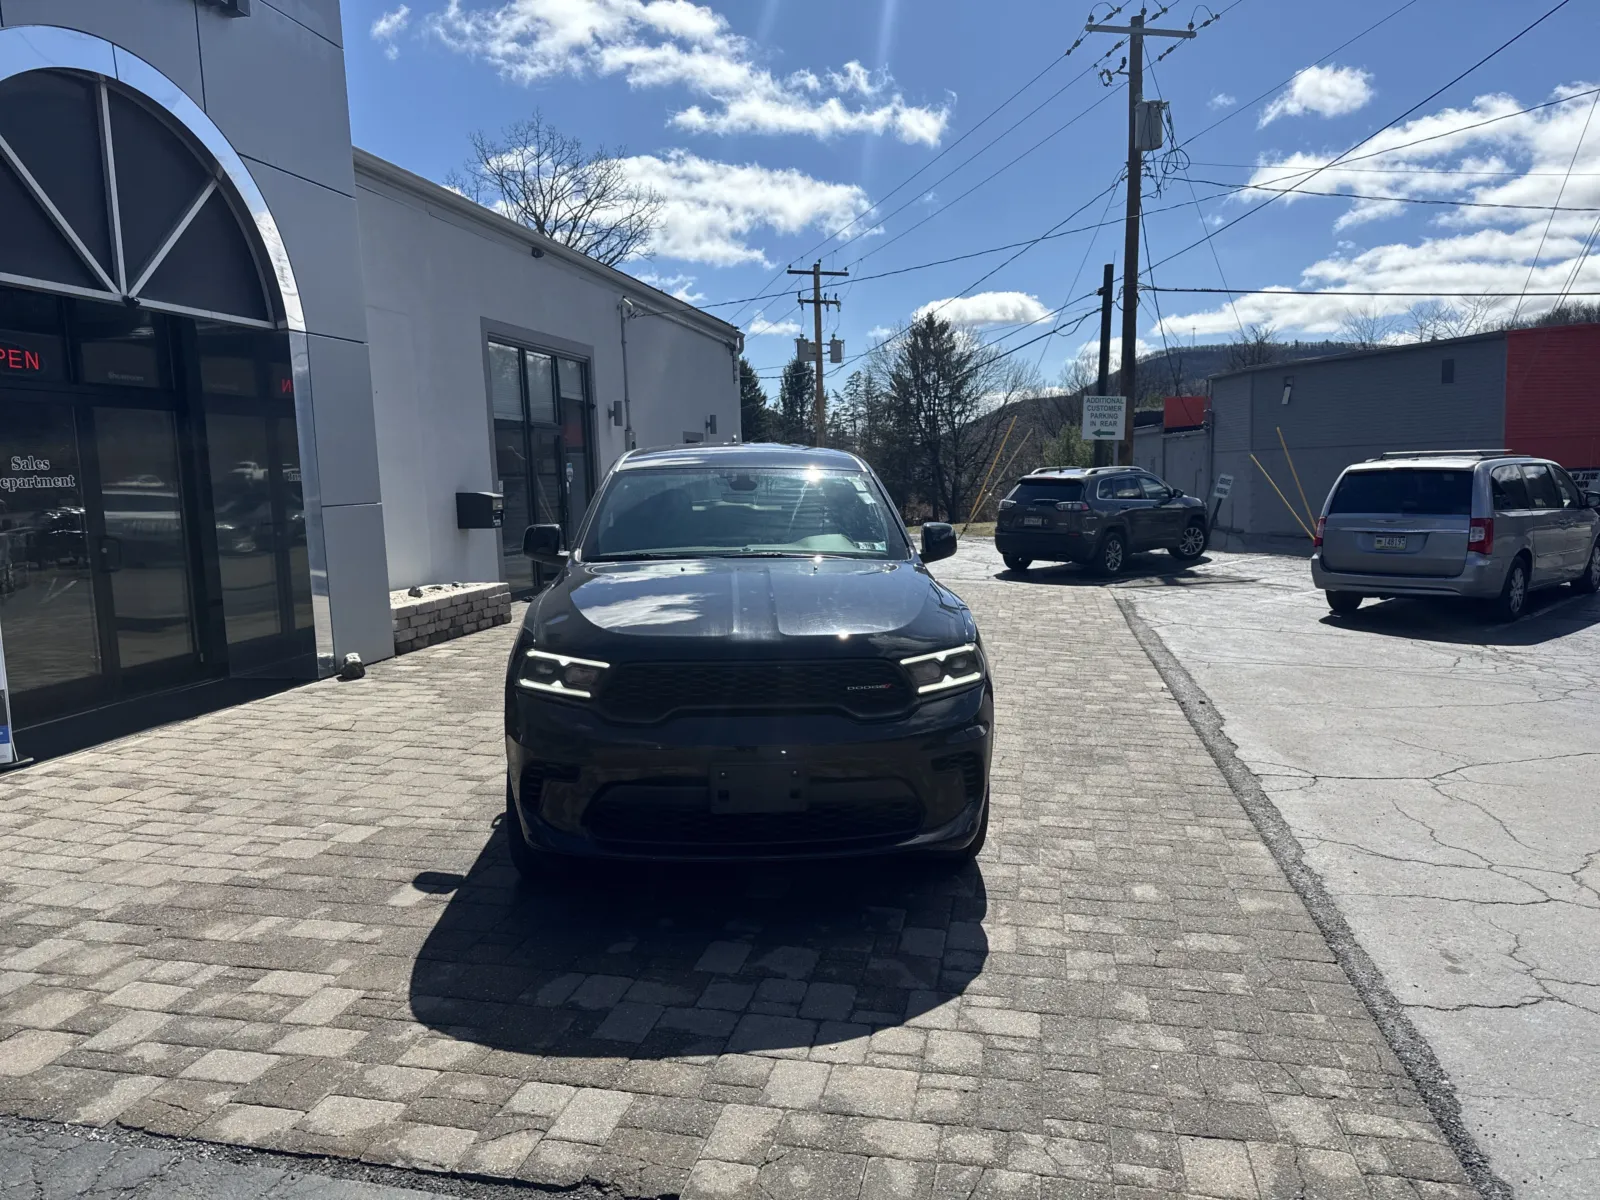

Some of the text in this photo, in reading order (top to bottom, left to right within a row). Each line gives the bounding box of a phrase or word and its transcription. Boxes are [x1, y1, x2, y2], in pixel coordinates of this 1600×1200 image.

[1086, 397, 1124, 405] ADDITIONAL
[1086, 404, 1122, 412] CUSTOMER
[1090, 412, 1119, 420] PARKING
[11, 455, 50, 471] Sales
